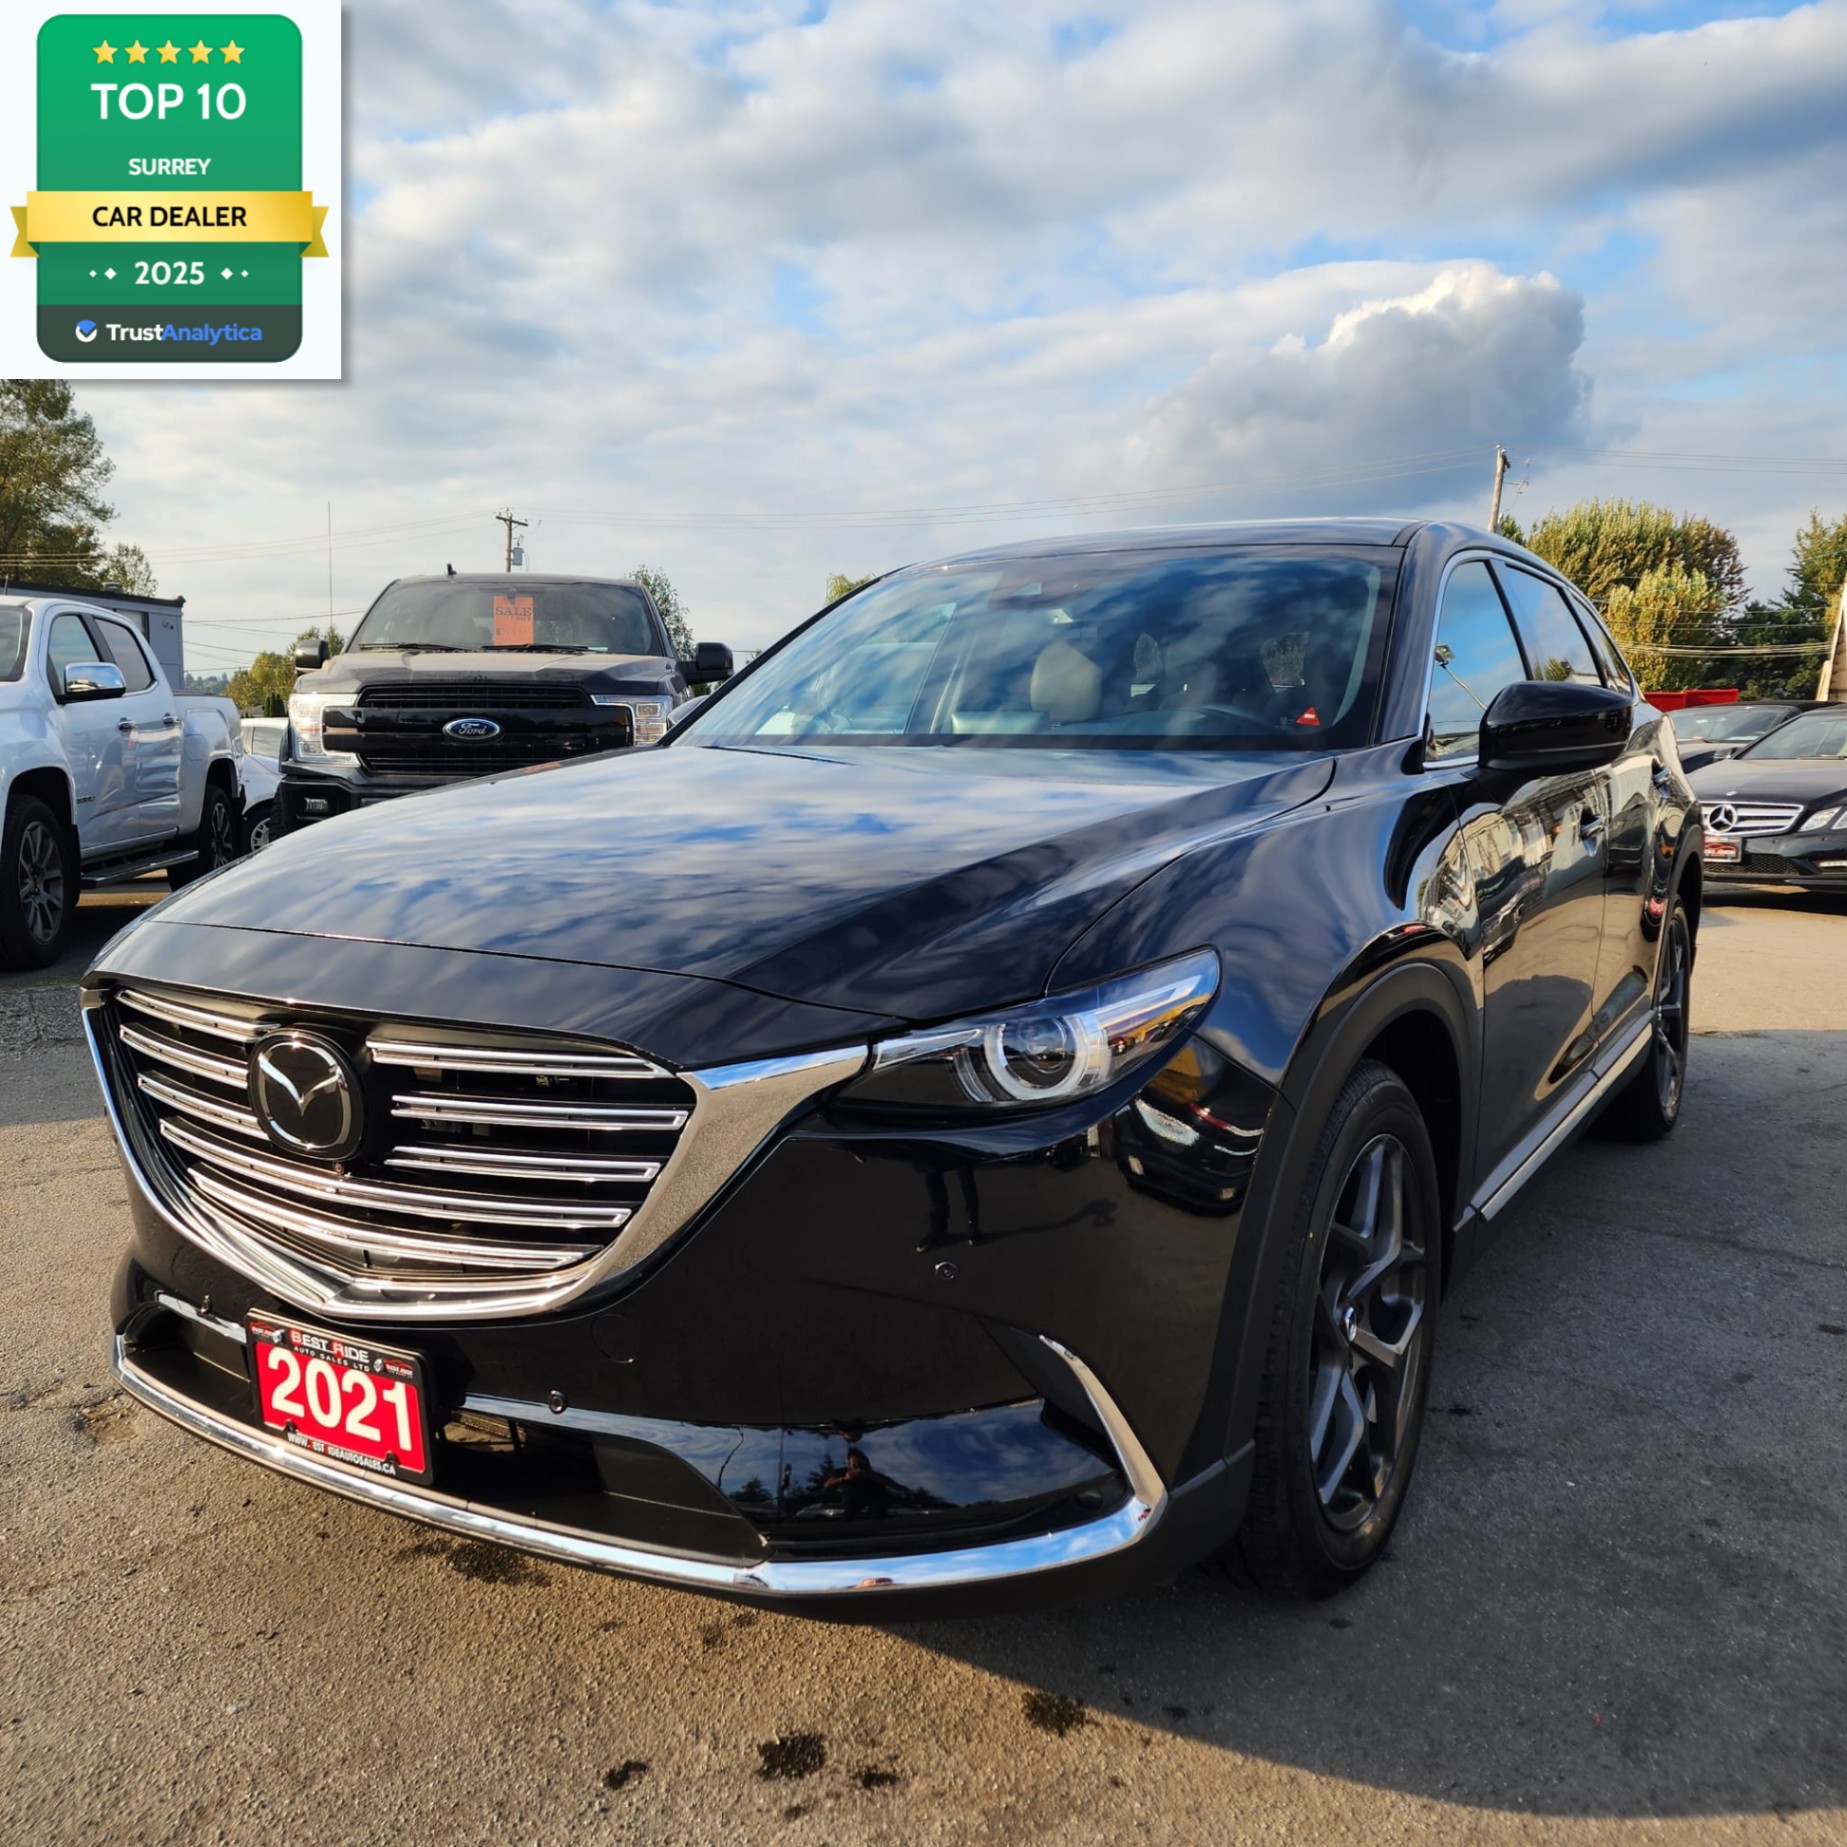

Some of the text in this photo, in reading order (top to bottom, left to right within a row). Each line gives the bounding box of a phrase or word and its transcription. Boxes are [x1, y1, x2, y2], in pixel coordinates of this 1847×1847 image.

[495, 606, 531, 616] SALE
[458, 723, 487, 734] Ford
[291, 1330, 328, 1351] BEST
[333, 1342, 370, 1363] RIDE
[293, 1346, 370, 1373] AUTO SALES LTD
[267, 1346, 412, 1452] 2021
[287, 1432, 396, 1475] WWW.ESTIDEAUTOSALES.CA
